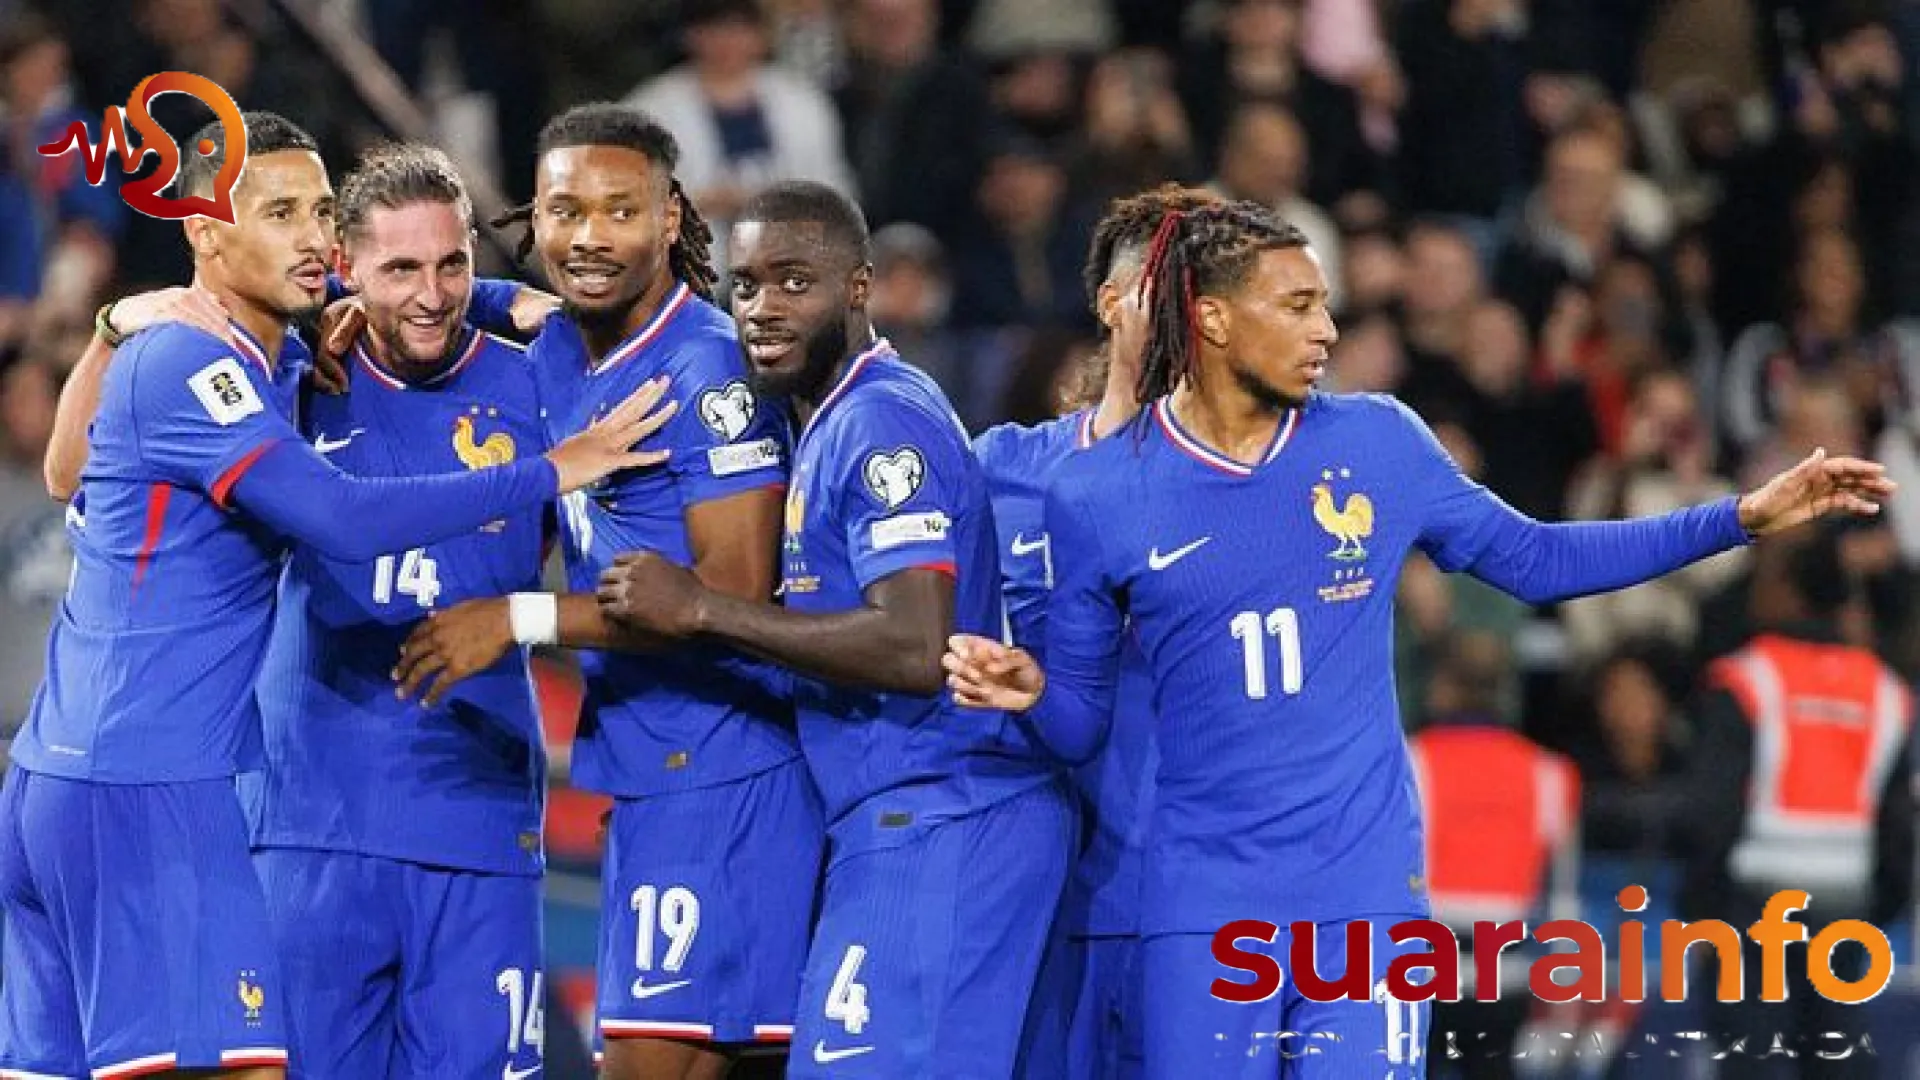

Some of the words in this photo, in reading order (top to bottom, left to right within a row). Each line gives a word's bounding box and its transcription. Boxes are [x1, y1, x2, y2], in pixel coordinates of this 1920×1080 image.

[373, 547, 441, 607] 14
[1229, 607, 1303, 700] 11
[630, 884, 700, 972] 19
[496, 968, 544, 1057] 14
[825, 945, 870, 1034] 4
